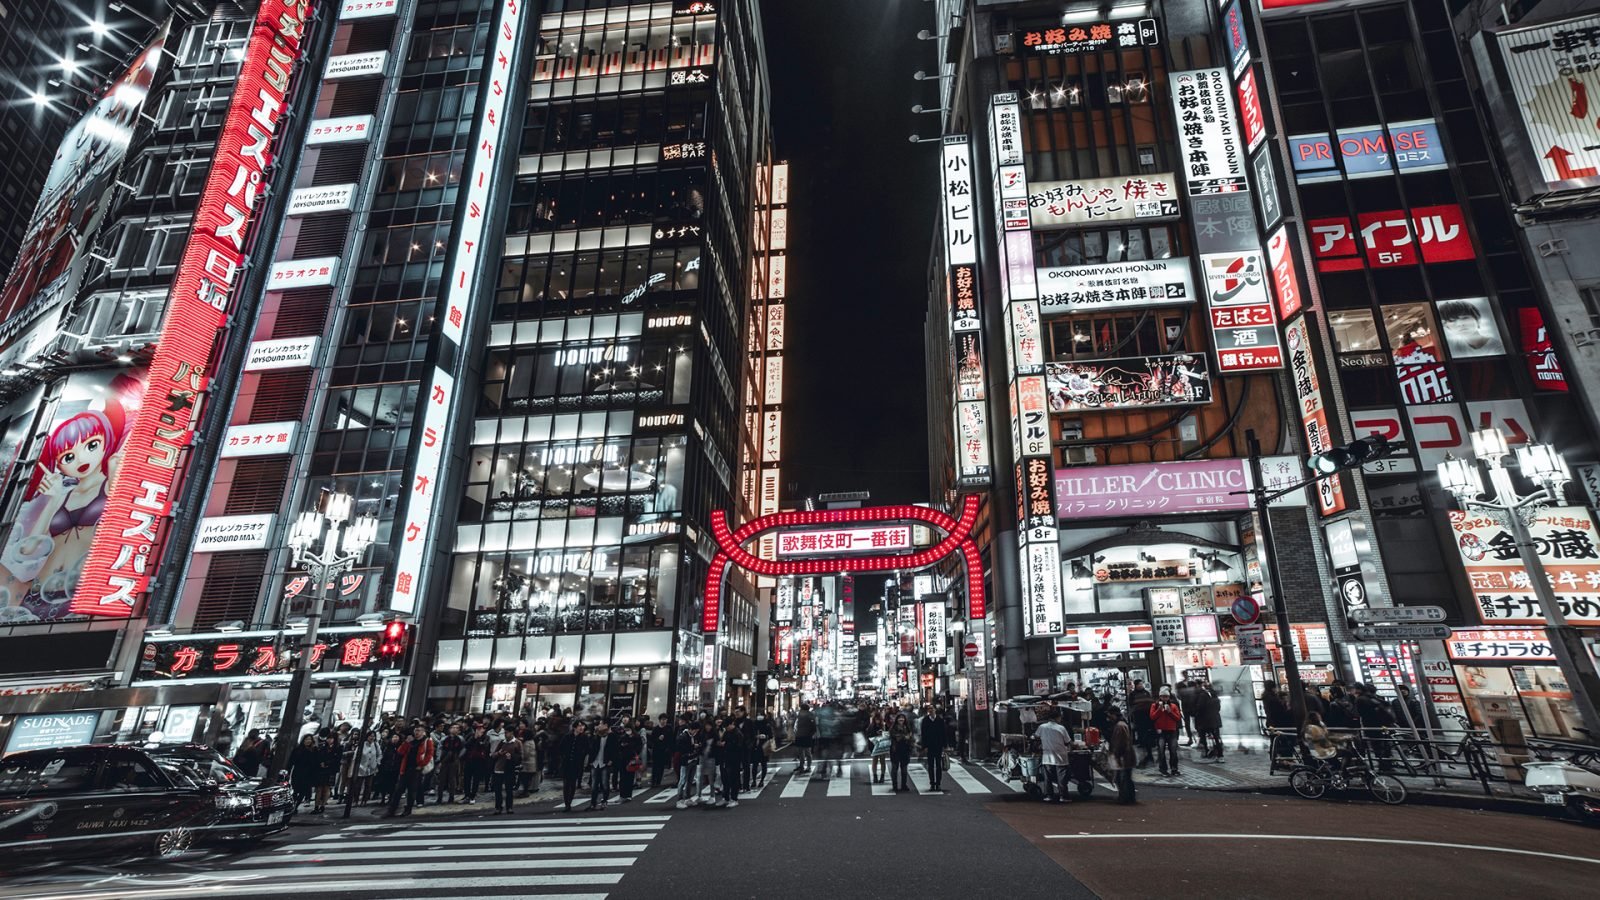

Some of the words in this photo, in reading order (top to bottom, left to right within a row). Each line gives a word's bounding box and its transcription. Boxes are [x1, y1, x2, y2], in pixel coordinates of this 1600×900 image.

[1024, 24, 1112, 46] お好み焼
[1142, 28, 1154, 37] 8F
[313, 123, 365, 135] カラオケ館
[1178, 84, 1211, 177] お好み焼き本陣
[1211, 71, 1232, 135] OKONOMIYAKI
[1224, 138, 1239, 174] HONJIN
[682, 150, 704, 158] BAR
[1299, 130, 1428, 161] PROMISE
[1376, 150, 1431, 165] プロミス
[1029, 184, 1083, 208] お好み
[1122, 179, 1168, 201] 焼き
[948, 156, 973, 246] 小松ビル
[1047, 188, 1113, 216] もんじゃ
[1084, 198, 1123, 218] たこ
[1162, 203, 1178, 215] 7F
[1312, 215, 1459, 251] アイフル
[1379, 252, 1402, 264] 5F
[275, 266, 329, 280] カラオケ館
[1048, 268, 1122, 279] OKONOMIYAKI
[1126, 263, 1167, 273] HONJIN
[957, 266, 975, 310] お好み焼
[1167, 285, 1185, 297] 2F
[1278, 261, 1294, 304] アコム
[1041, 286, 1147, 306] お好み焼き本陣
[1215, 308, 1270, 325] たばこ
[1285, 302, 1295, 314] 3F
[648, 315, 691, 328] DOUTOR
[1232, 329, 1258, 346] 酒
[251, 354, 286, 364] JOYSOUND
[286, 353, 301, 361] MAX
[554, 345, 629, 366] DOUTOR
[1222, 352, 1279, 366] 銀行ATM
[1340, 358, 1382, 367] Neolive
[1292, 350, 1313, 399] 金の蔵
[1185, 387, 1204, 401] 4F
[1305, 398, 1319, 413] 2F
[147, 360, 206, 470] パチンコ
[639, 413, 684, 428] DOUTOR
[1025, 411, 1048, 440] ブル
[229, 433, 288, 446] カラオケ館
[1029, 443, 1044, 453] 6F
[541, 444, 618, 466] DOUTOR
[1375, 460, 1397, 472] 3F
[396, 384, 445, 595] カラオケ館
[1029, 459, 1051, 515] お好み焼
[1056, 475, 1138, 497] FILLER
[1157, 469, 1244, 491] CLINIC
[1105, 496, 1170, 511] クリニック
[1449, 511, 1465, 522] 2F
[629, 521, 676, 535] DOUTOR
[1034, 529, 1052, 539] 8F
[100, 480, 170, 606] エスパス
[201, 534, 239, 544] JOYSOUND
[239, 533, 256, 541] MAX
[257, 532, 263, 540] 2
[782, 529, 907, 552] 歌舞伎町一番街
[1488, 529, 1599, 560] 金の蔵
[526, 551, 608, 575] DOUTOR
[1478, 595, 1498, 617] 東京
[22, 715, 94, 729] SUBNADE
[76, 822, 104, 830] DAIWA
